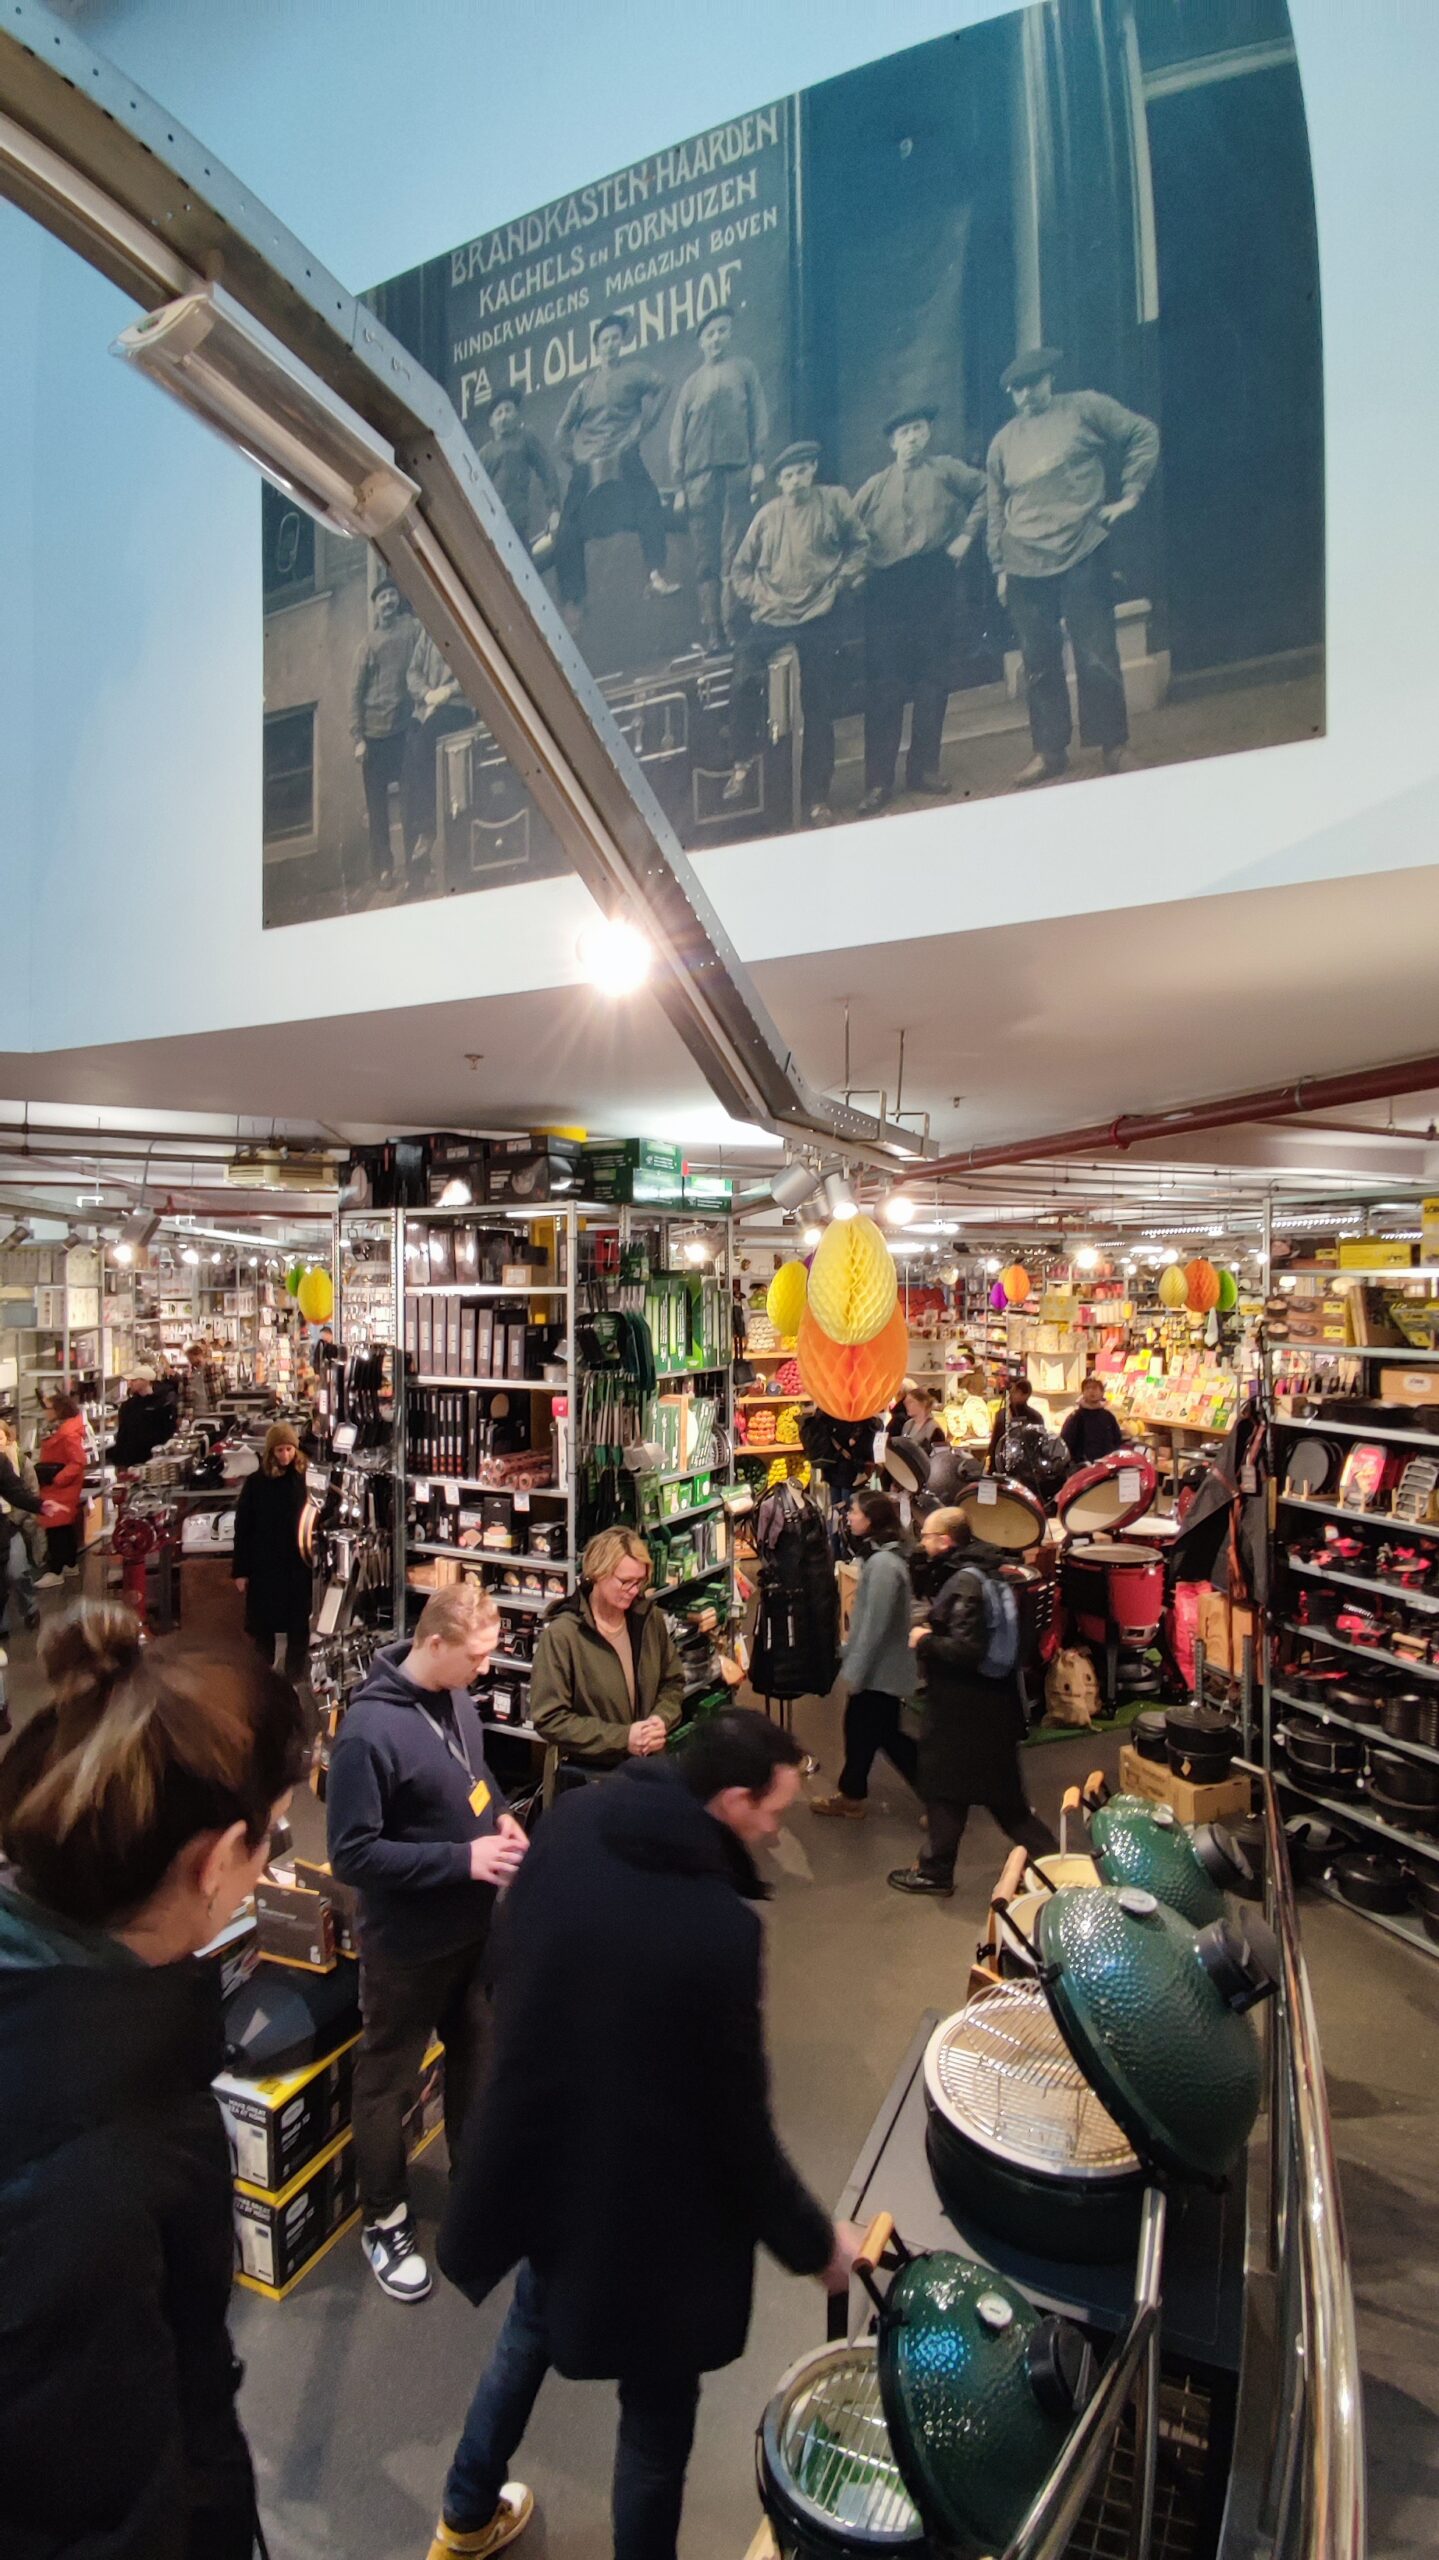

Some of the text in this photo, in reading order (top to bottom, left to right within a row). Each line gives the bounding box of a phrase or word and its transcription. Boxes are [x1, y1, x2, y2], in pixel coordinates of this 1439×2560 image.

[656, 106, 779, 194] HAARDEN
[453, 206, 778, 364] KINDERWAGENS MAGAZIJN BOVEN
[479, 168, 758, 318] KACHELS EN FORNUIZEN
